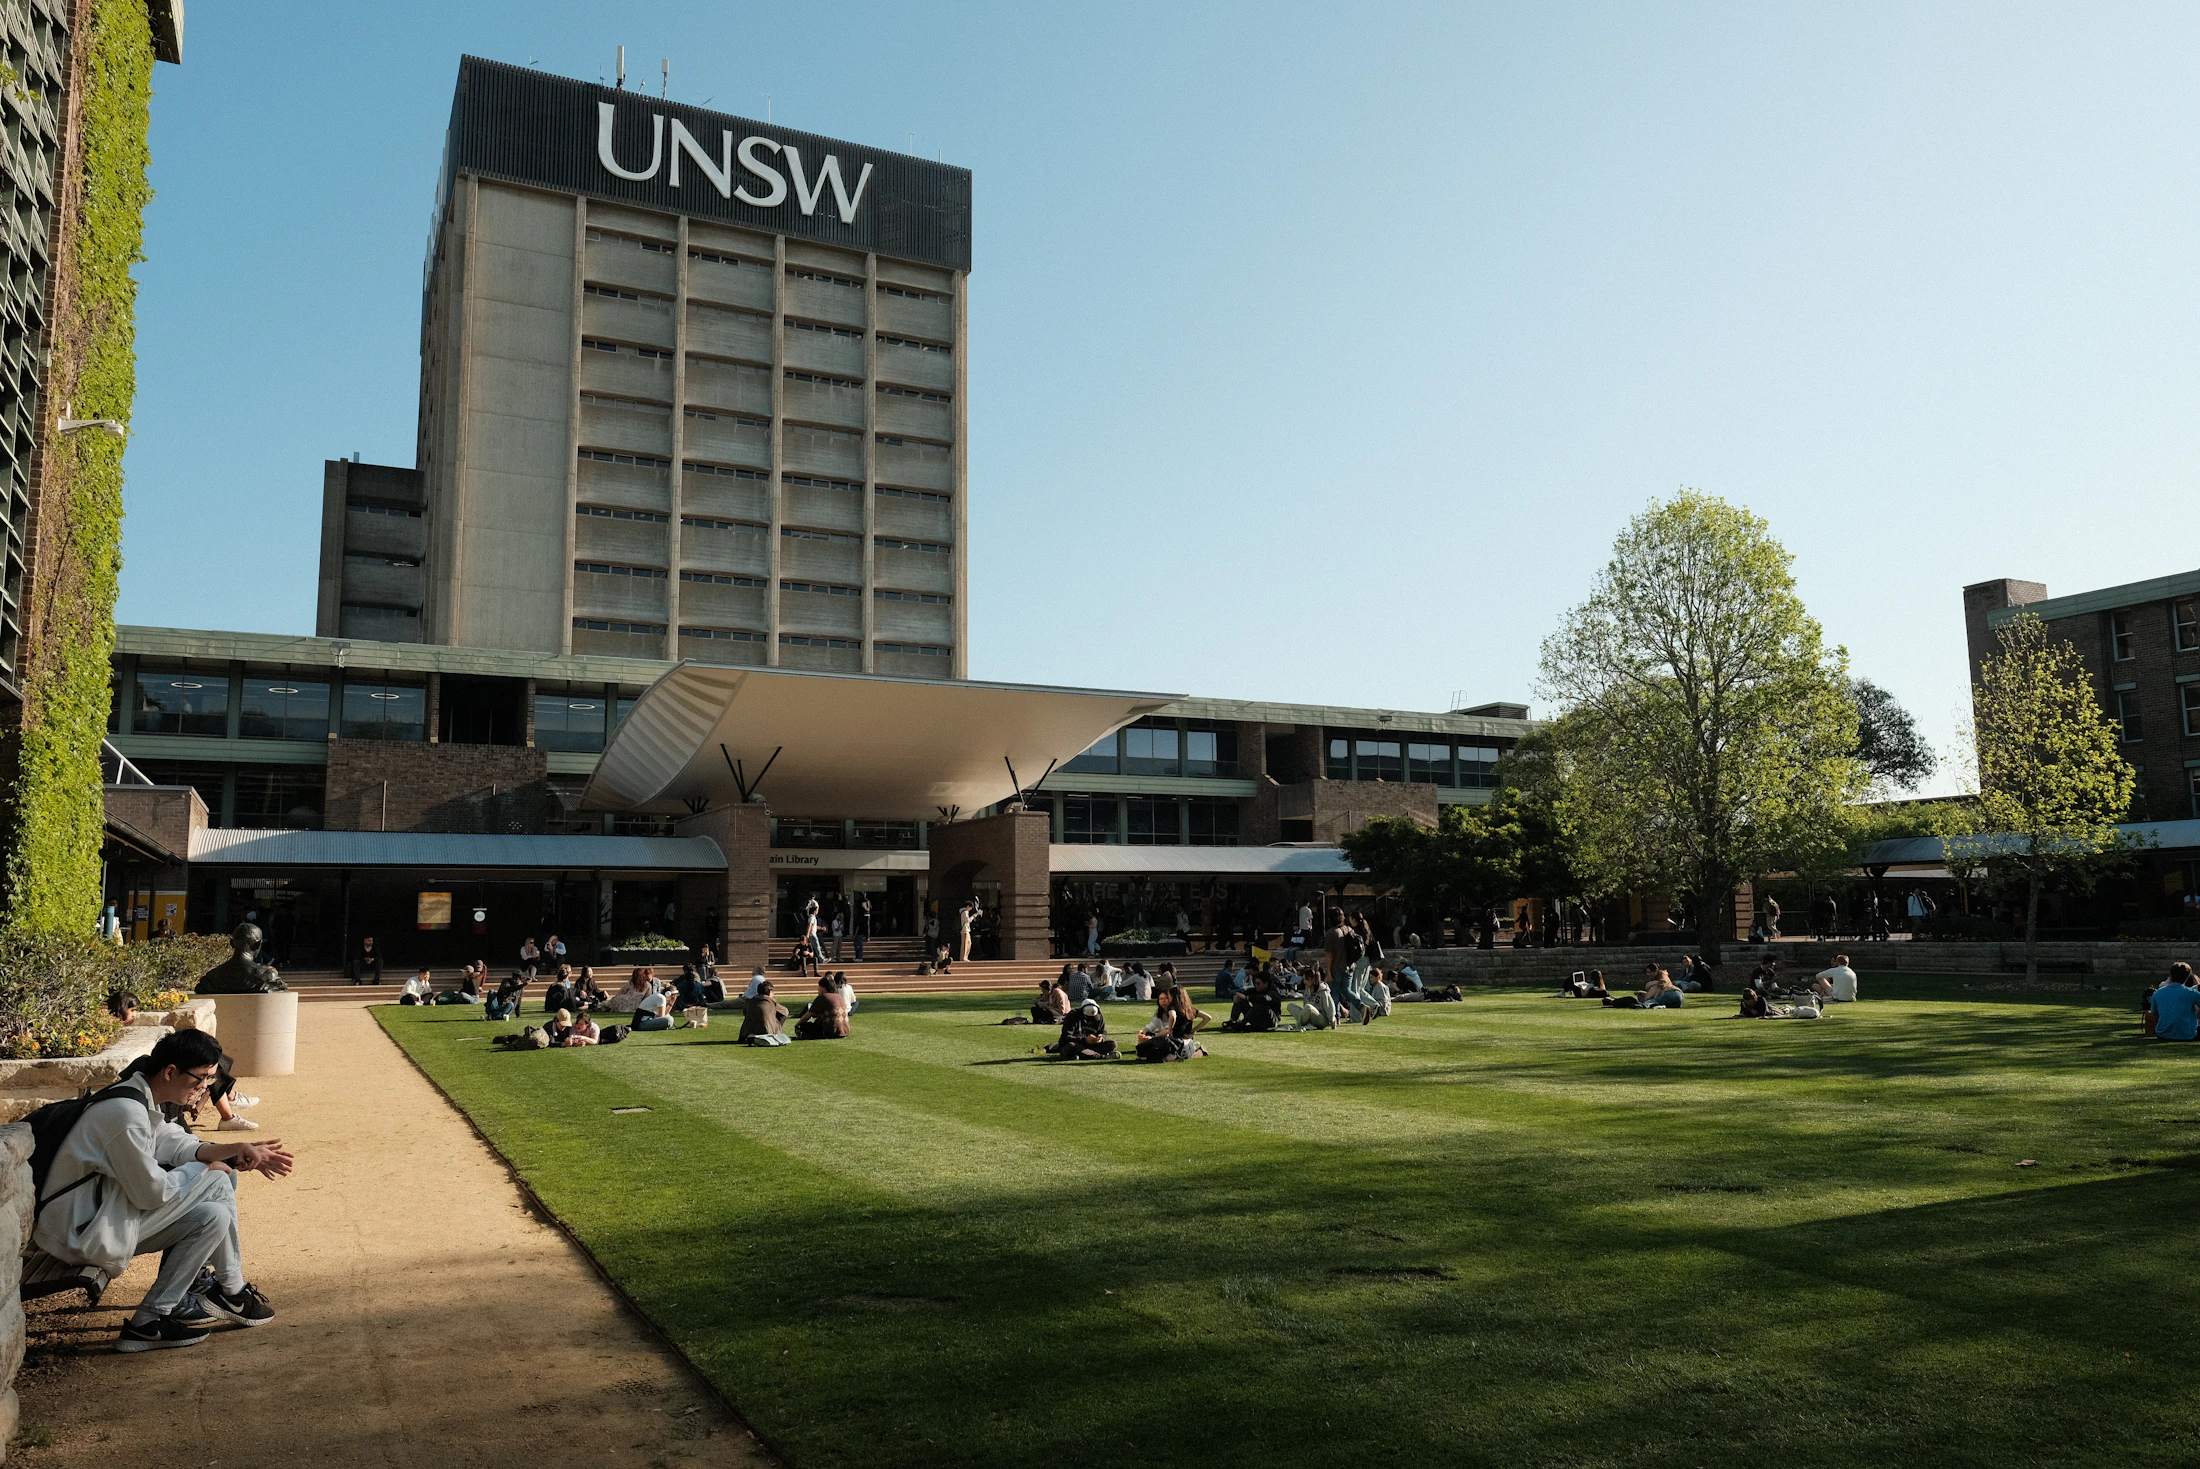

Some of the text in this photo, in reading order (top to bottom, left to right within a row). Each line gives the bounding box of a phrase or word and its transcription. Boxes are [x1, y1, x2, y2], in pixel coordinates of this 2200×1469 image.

[598, 101, 874, 225] UNSW
[769, 854, 819, 866] ain Library
